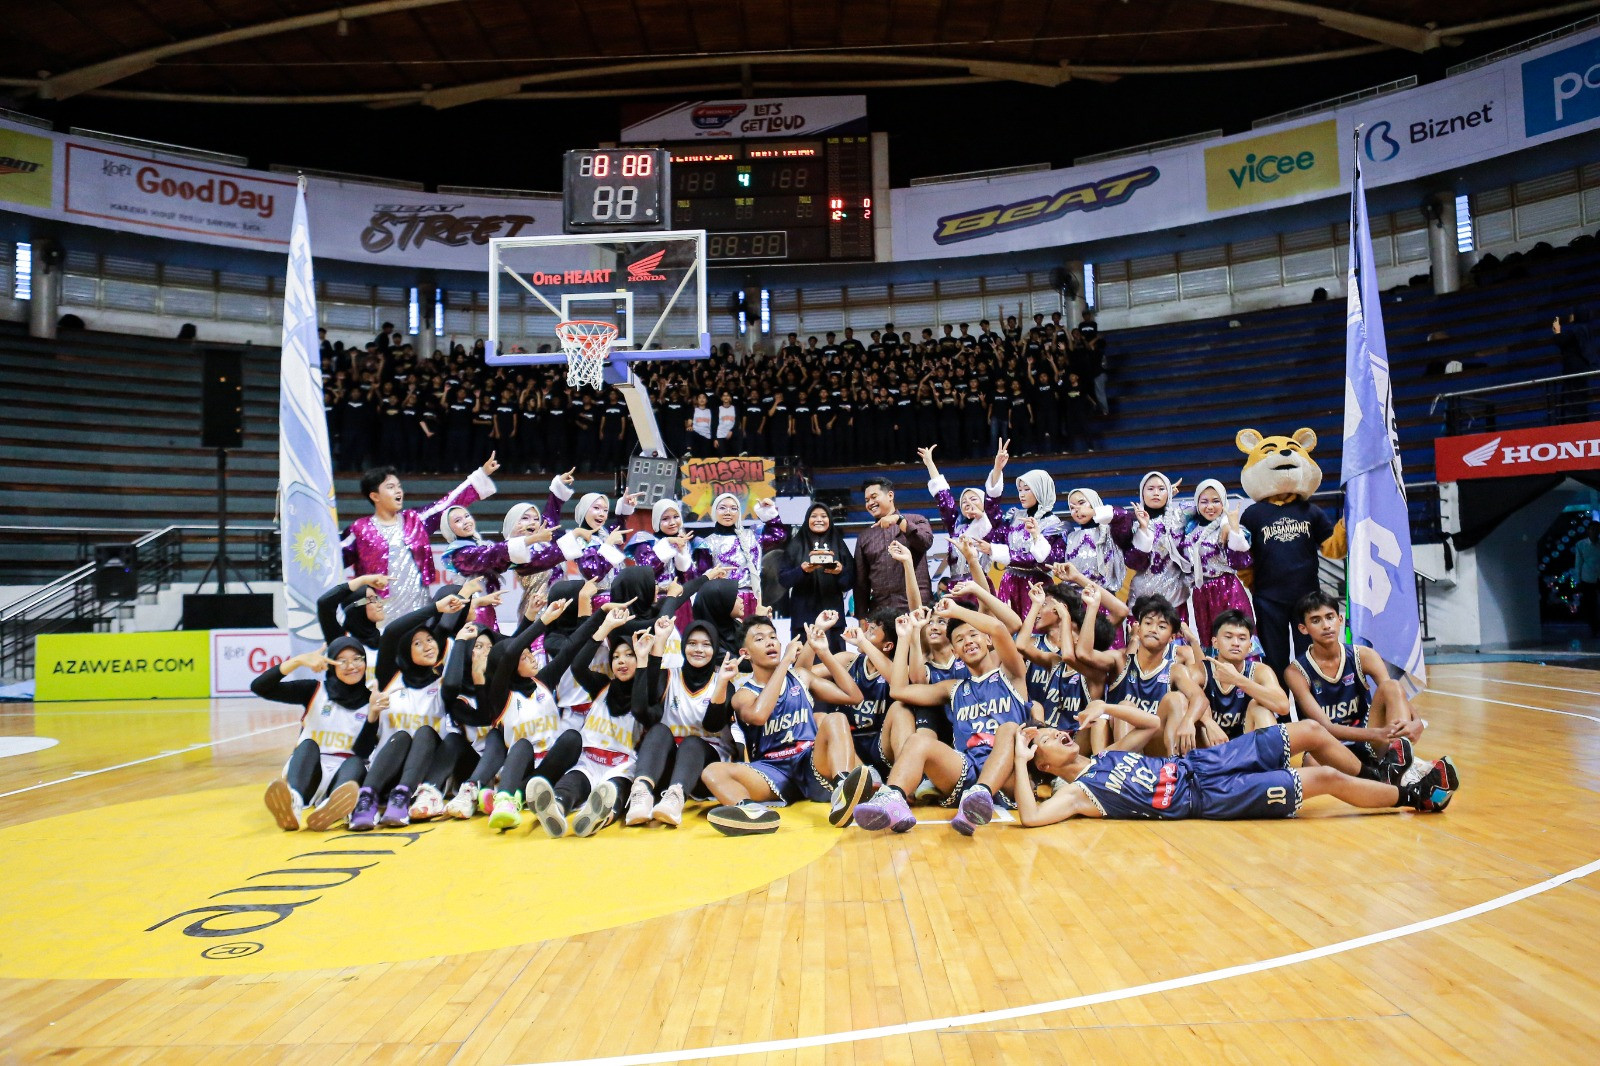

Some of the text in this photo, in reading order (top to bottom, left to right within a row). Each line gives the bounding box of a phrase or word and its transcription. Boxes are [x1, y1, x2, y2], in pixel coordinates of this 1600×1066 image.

[753, 102, 783, 117] LET'S
[740, 114, 806, 133] GET LOUD
[1409, 104, 1493, 144] Biznet
[360, 211, 536, 253] STREET
[533, 268, 612, 286] One HEART
[627, 274, 667, 282] HONDA
[53, 658, 194, 674] AZAWEAR.COM
[957, 696, 1011, 721] MUSAN
[763, 708, 809, 737] MUSAN
[780, 730, 795, 744] 4
[1104, 751, 1144, 795] MUSAN
[1130, 766, 1158, 793] 10
[1266, 786, 1287, 805] 10
